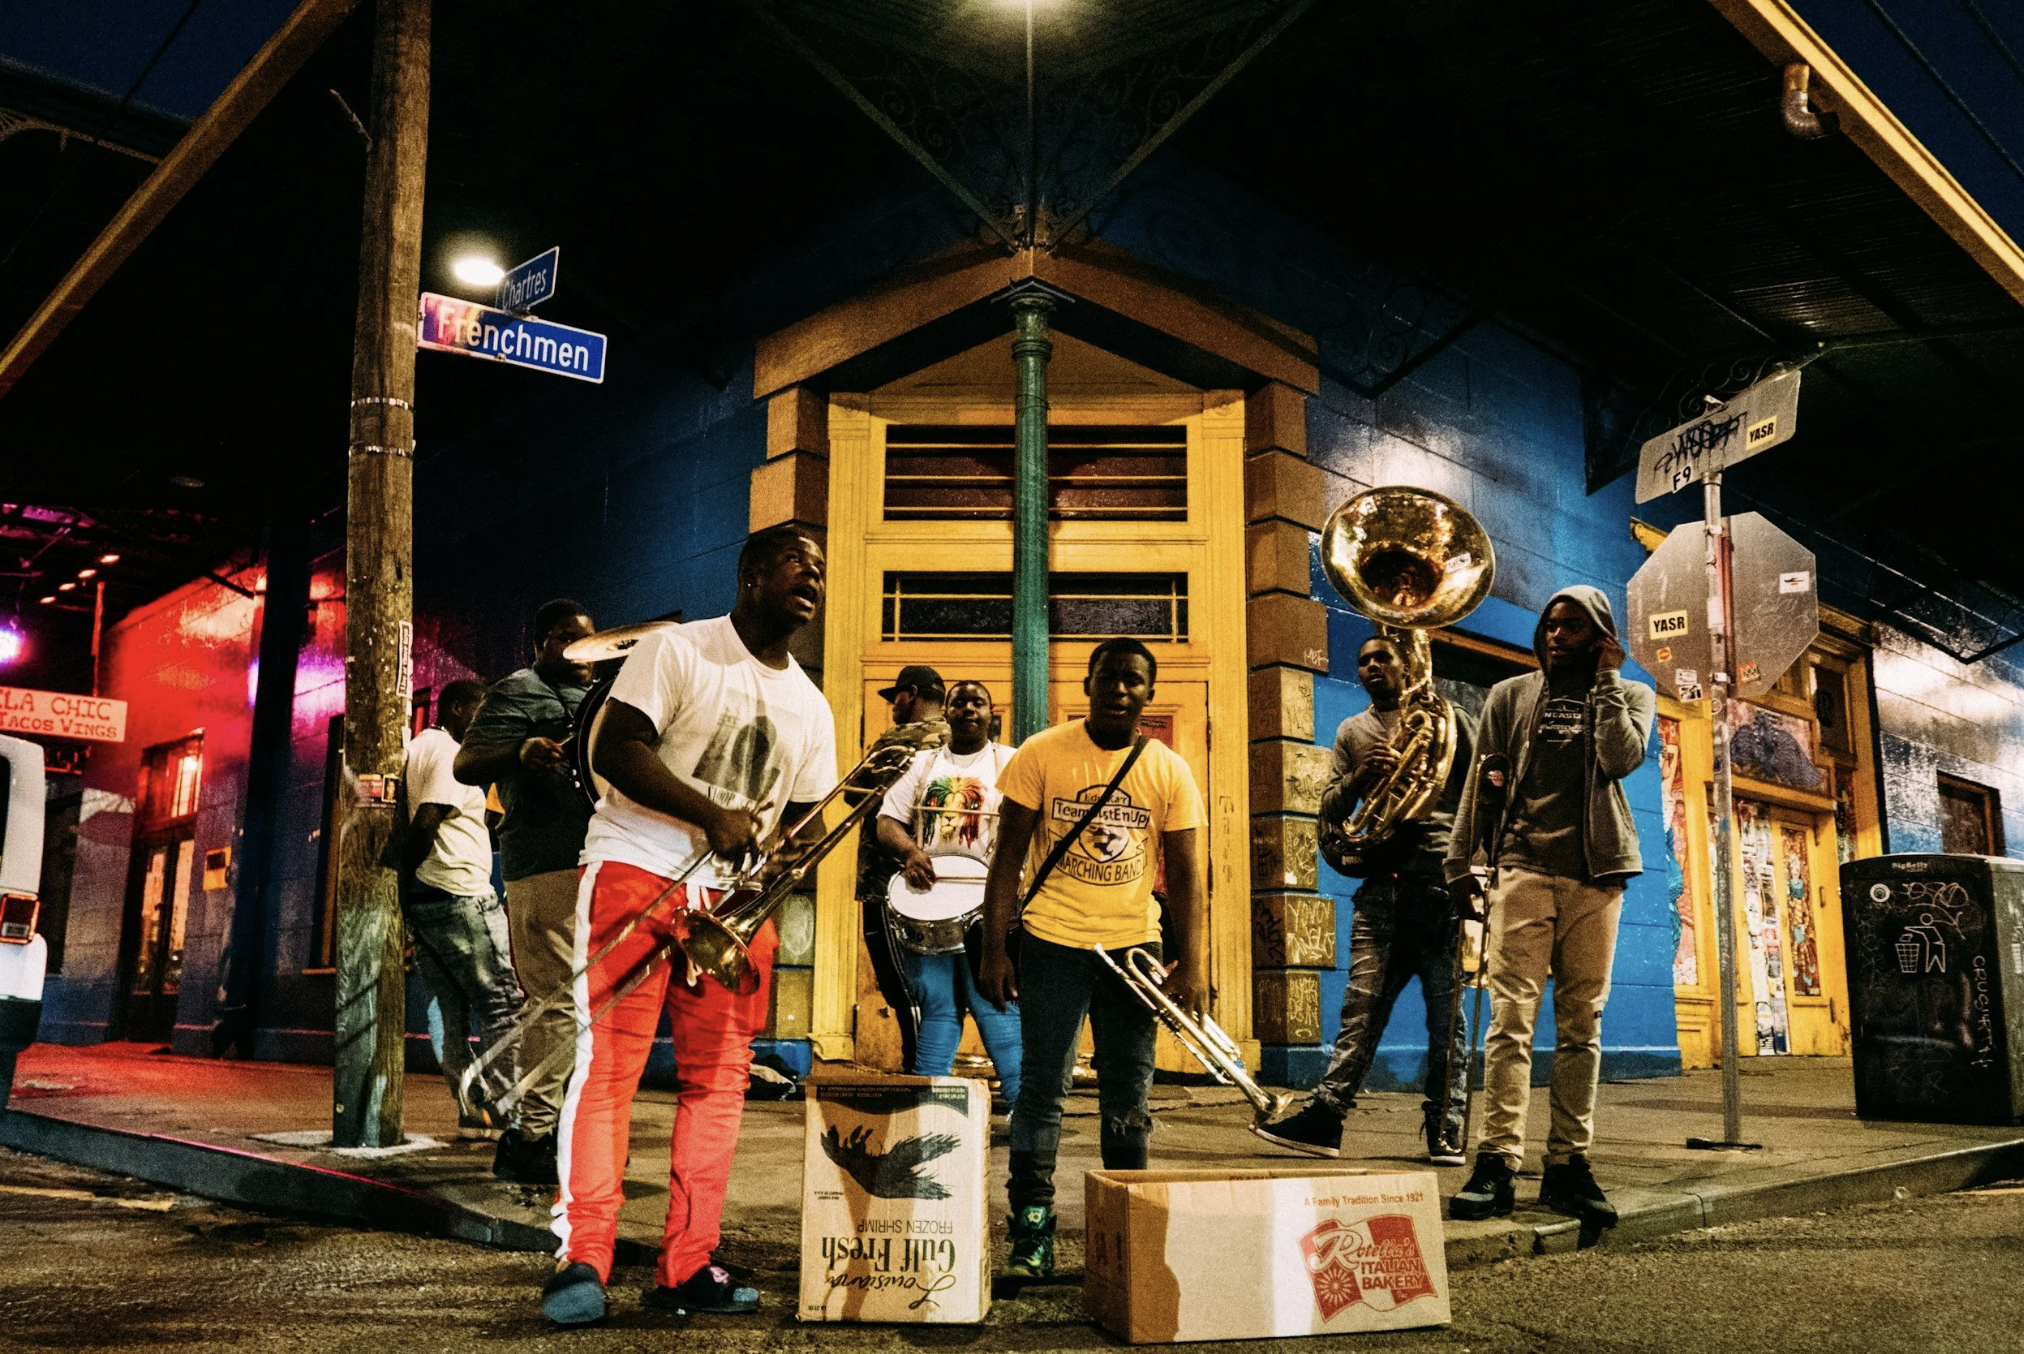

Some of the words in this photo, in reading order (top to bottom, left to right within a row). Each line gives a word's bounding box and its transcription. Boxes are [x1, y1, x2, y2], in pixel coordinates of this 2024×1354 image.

[502, 268, 547, 310] Chartres
[437, 305, 589, 372] Frenchmen
[1749, 422, 1774, 443] YASR
[1672, 466, 1691, 491] F9
[1653, 616, 1686, 633] YASR
[51, 697, 111, 720] CHIC
[1115, 859, 1141, 881] BAND
[1304, 1197, 1310, 1206] A
[1312, 1196, 1340, 1208] Family
[1342, 1195, 1379, 1206] Tradition
[1381, 1193, 1404, 1204] Since
[1406, 1191, 1424, 1203] 1921
[857, 1219, 903, 1233] SHRIMP
[906, 1220, 953, 1234] FROZEN
[821, 1236, 891, 1272] Fresh
[900, 1238, 956, 1273] Gulf
[1308, 1229, 1415, 1271] Rotella's
[1361, 1257, 1422, 1275] ITALIAN
[826, 1274, 956, 1310] Louisiana
[1361, 1272, 1425, 1290] BAKERY
